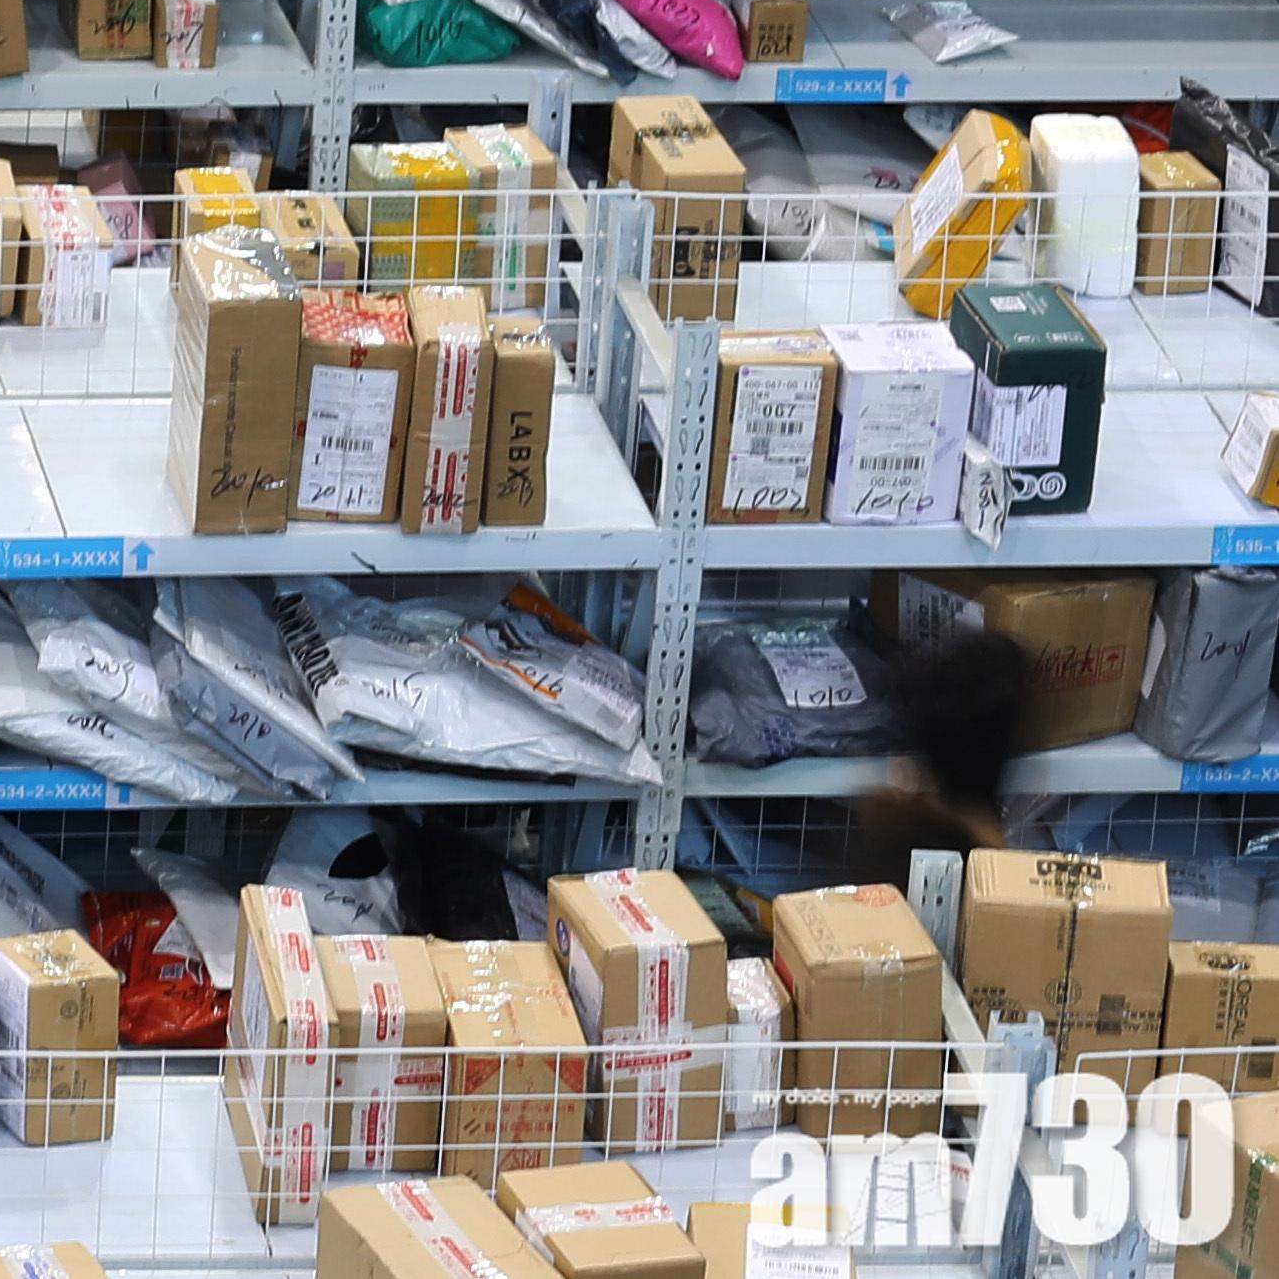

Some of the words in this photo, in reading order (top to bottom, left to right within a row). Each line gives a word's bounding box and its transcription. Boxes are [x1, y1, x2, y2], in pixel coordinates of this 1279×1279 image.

[794, 79, 883, 93] 529-2-XXXX
[762, 403, 798, 419] 067
[12, 550, 121, 568] 534-1-XXXX
[793, 687, 853, 714] 1010
